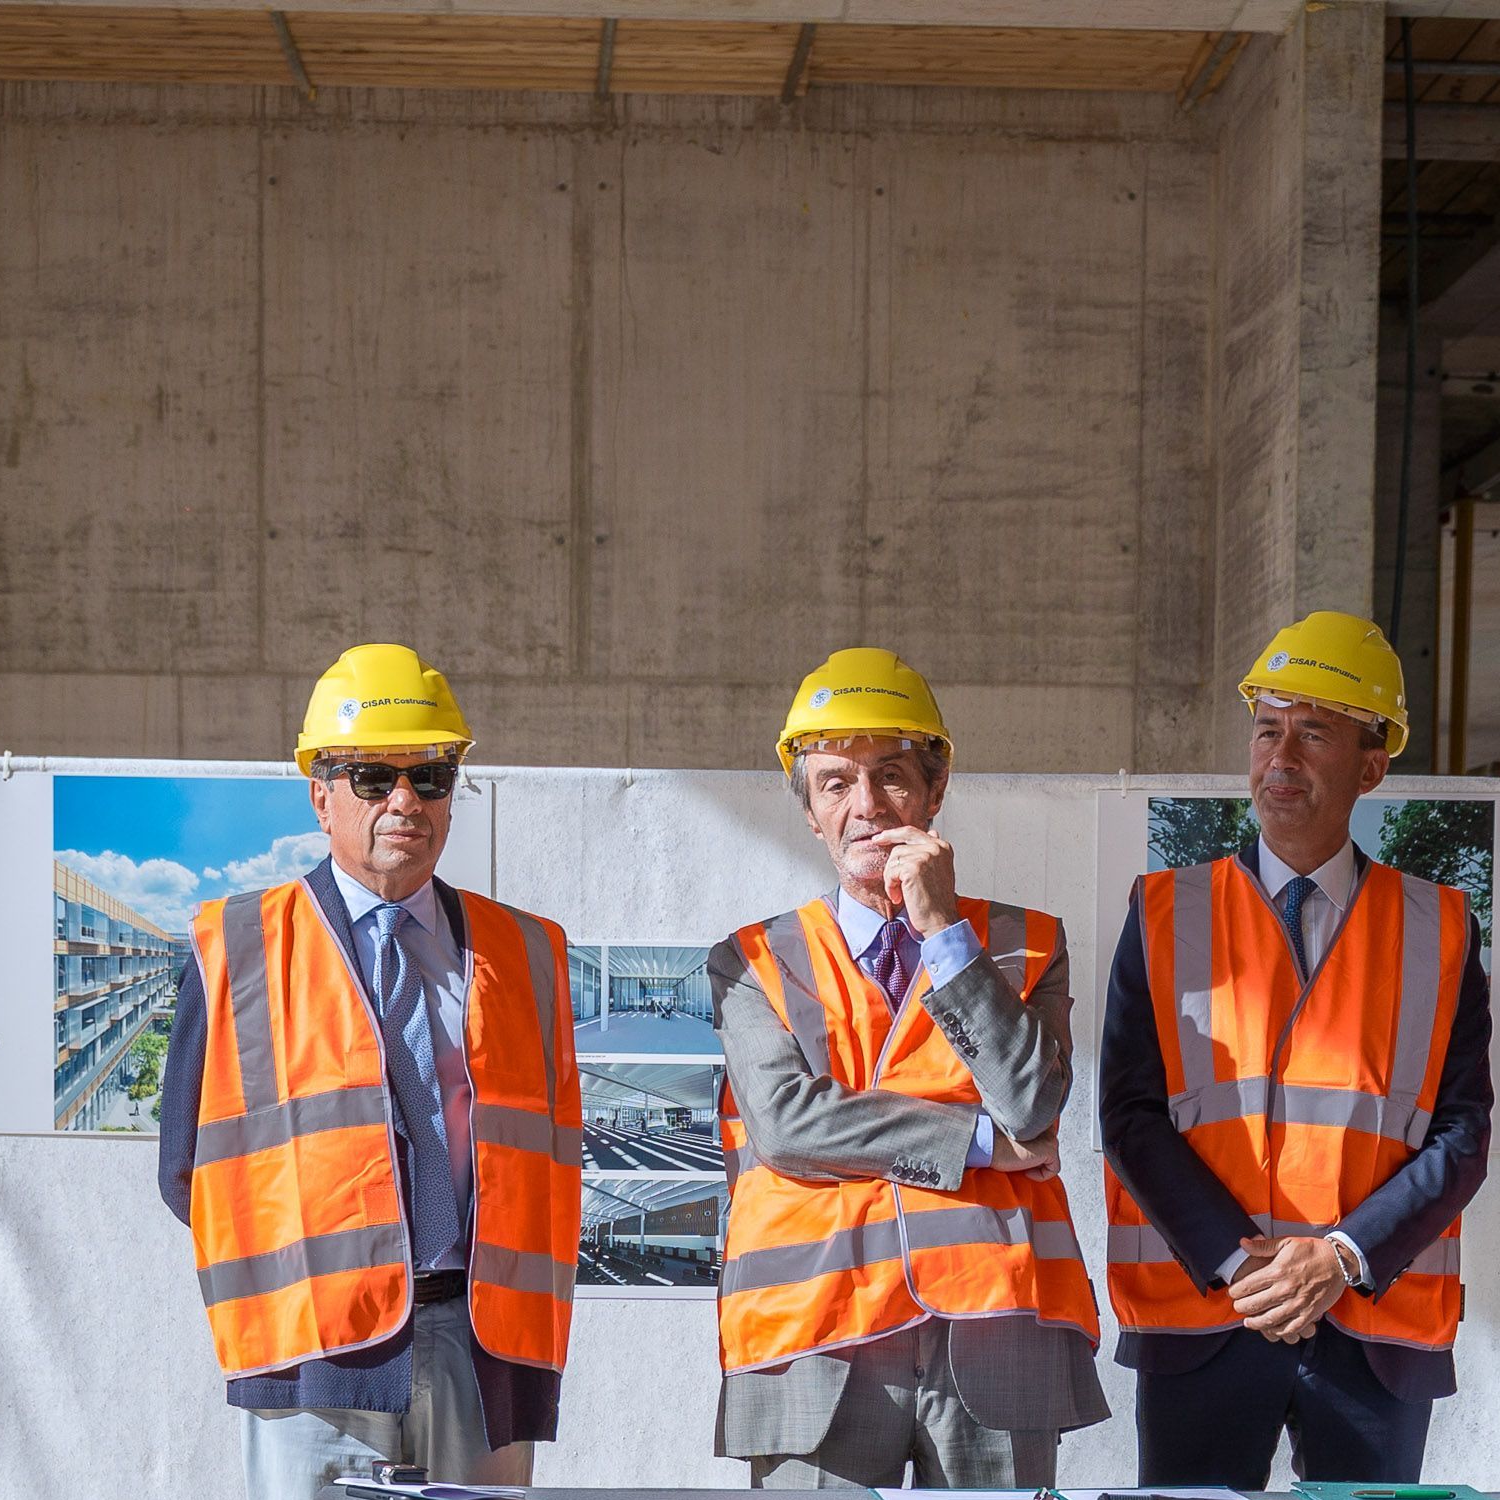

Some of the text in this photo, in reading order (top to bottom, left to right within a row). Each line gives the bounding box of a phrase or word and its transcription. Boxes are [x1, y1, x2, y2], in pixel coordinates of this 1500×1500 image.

[1288, 657, 1362, 683] CISAR Costruzioni
[833, 686, 862, 696] CISAR
[361, 698, 392, 709] CISAR
